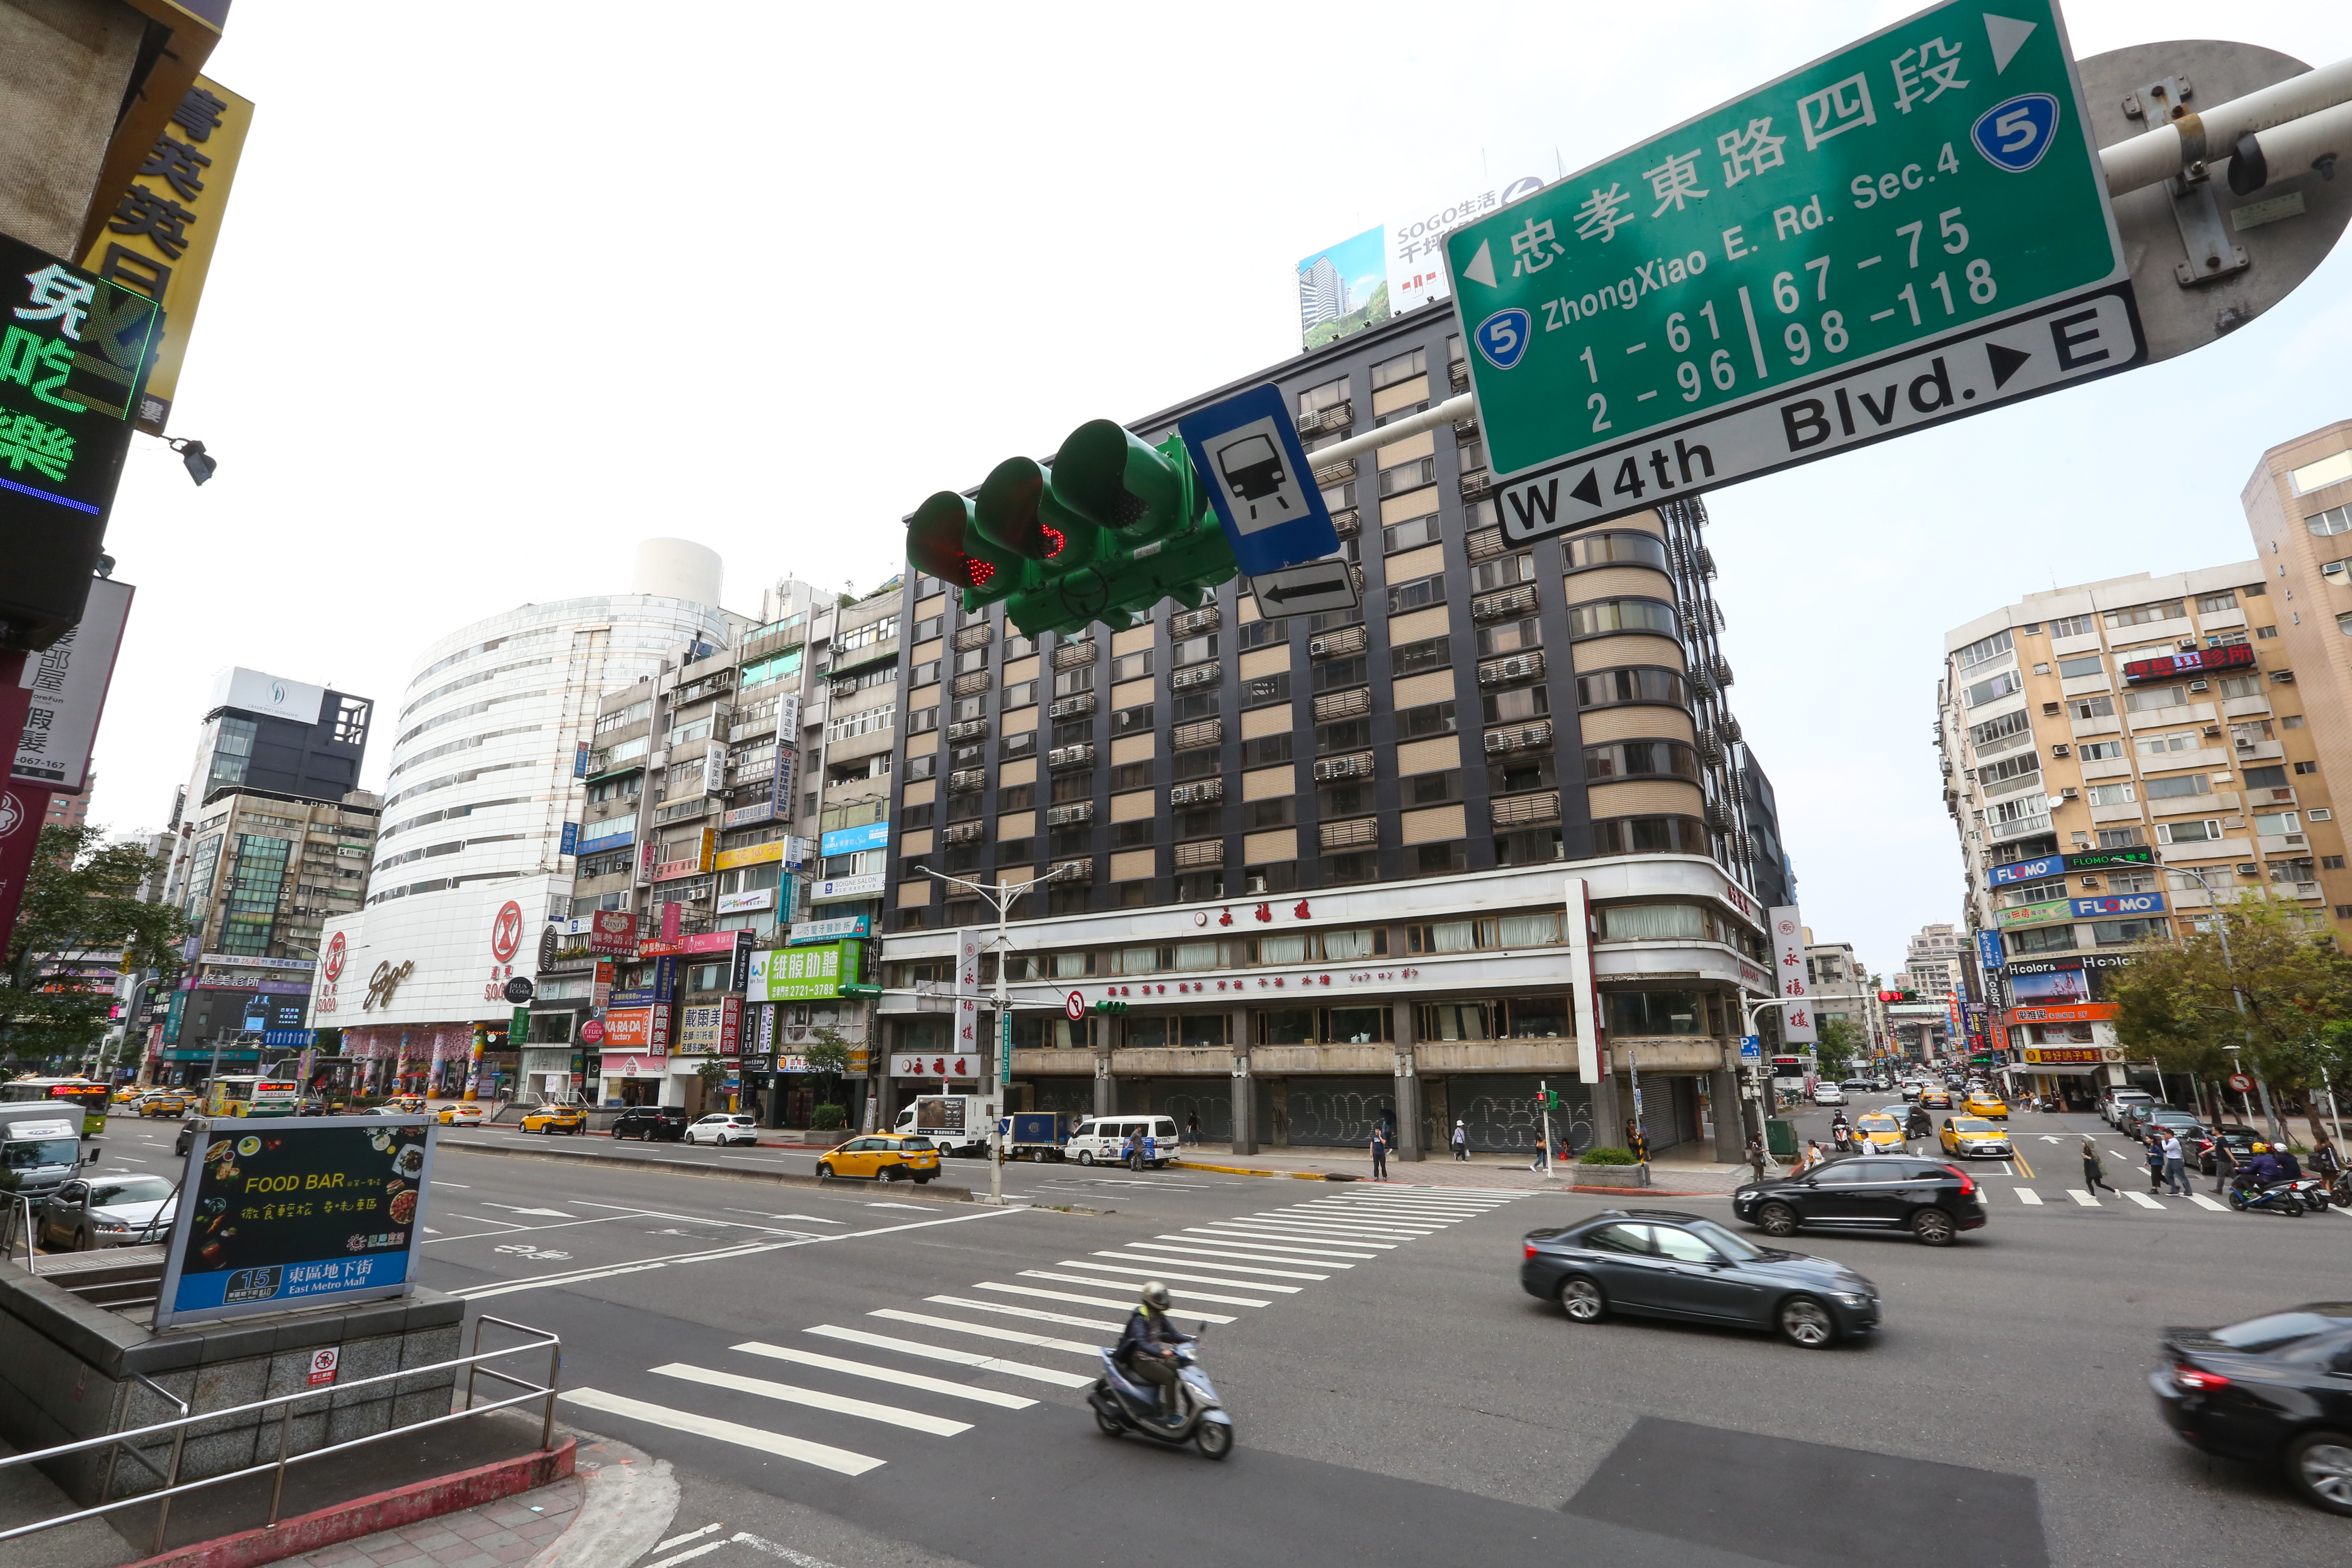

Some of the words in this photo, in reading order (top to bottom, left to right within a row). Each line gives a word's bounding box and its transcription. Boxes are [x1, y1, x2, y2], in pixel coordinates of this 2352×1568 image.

[1993, 107, 2038, 156] 5
[1509, 37, 1971, 279] 忠孝東路四段
[1541, 247, 1706, 332] ZhongXiao
[1722, 221, 1759, 262] E.
[1774, 194, 1834, 243] Rd.
[1772, 255, 1834, 315] 67
[1897, 206, 1971, 268] 75
[1488, 317, 1518, 353] 5
[1579, 344, 1599, 383] 1
[1666, 299, 1721, 355] 61
[1785, 315, 1849, 366] 98
[1587, 393, 1612, 434] 2
[1676, 348, 1736, 403] 96
[1506, 478, 1560, 533] W
[1613, 444, 1715, 502] 4th
[1780, 357, 1979, 455] Blvd.
[2048, 307, 2110, 372] E
[33, 694, 64, 705] oreFun
[721, 843, 778, 863] 桃花仙子
[2073, 856, 2109, 865] FLOMO
[1997, 862, 2047, 882] FLOMO
[835, 879, 856, 888] SOIGNE
[1218, 899, 1311, 926] 永福樓
[2078, 896, 2151, 914] FLOMO
[601, 920, 629, 929] TRINITY
[592, 945, 632, 955] 8771-5643
[772, 950, 838, 980] 維膜助聽
[203, 974, 260, 988] 悠美診所
[510, 983, 527, 993] PLUS
[790, 983, 834, 997] 2721-3789
[1783, 947, 1809, 1028] 永福樓
[317, 997, 337, 1012] SOGO
[652, 1005, 668, 1056] 戴爾美語
[723, 998, 738, 1052] 戴爾美語
[612, 1033, 632, 1041] factory
[1739, 1038, 1750, 1049] P
[913, 1057, 966, 1075] 永福樓
[245, 1175, 300, 1193] FOOD
[305, 1173, 345, 1190] BAR
[241, 1202, 313, 1220] 微食輕旅
[241, 1269, 270, 1289] 15
[287, 1259, 373, 1284] 東區地下街
[228, 1290, 258, 1299] 東區地下街
[288, 1284, 309, 1295] East
[311, 1282, 341, 1292] Metro
[343, 1276, 366, 1287] Mall
